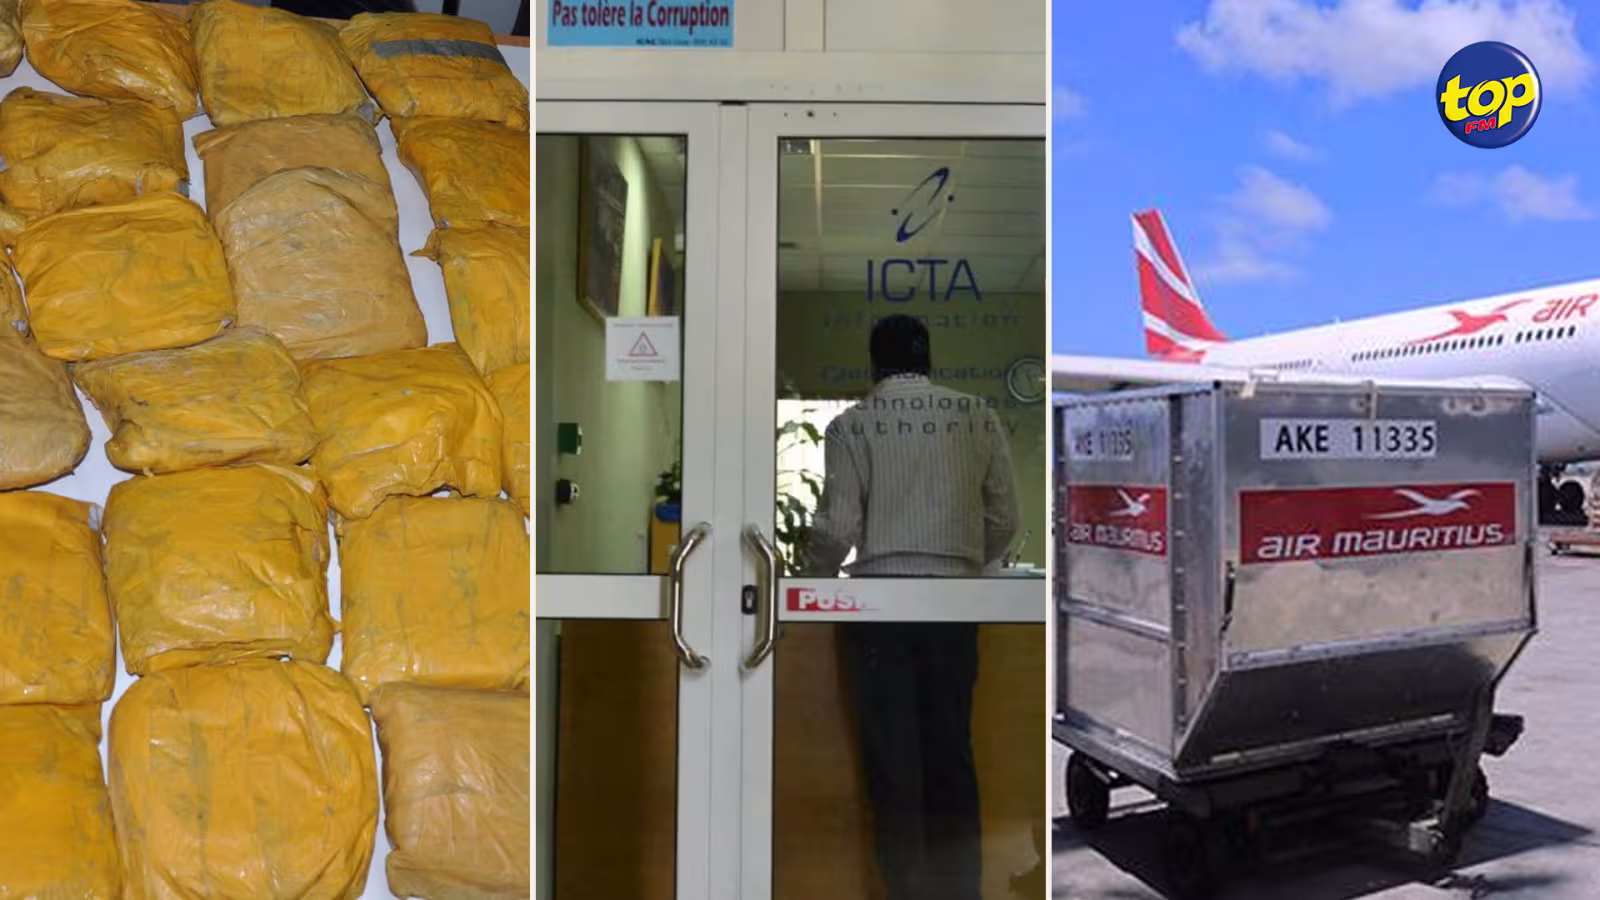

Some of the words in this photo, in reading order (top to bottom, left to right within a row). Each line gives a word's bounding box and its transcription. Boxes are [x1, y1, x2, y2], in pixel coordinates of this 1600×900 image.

[552, 1, 577, 27] Pas
[582, 0, 625, 27] tolère
[630, 0, 643, 27] la
[647, 0, 729, 35] Corruption
[867, 259, 983, 304] ICTA
[1275, 425, 1330, 452] AKE
[1353, 425, 1436, 452] 11335
[798, 590, 866, 610] PUS
